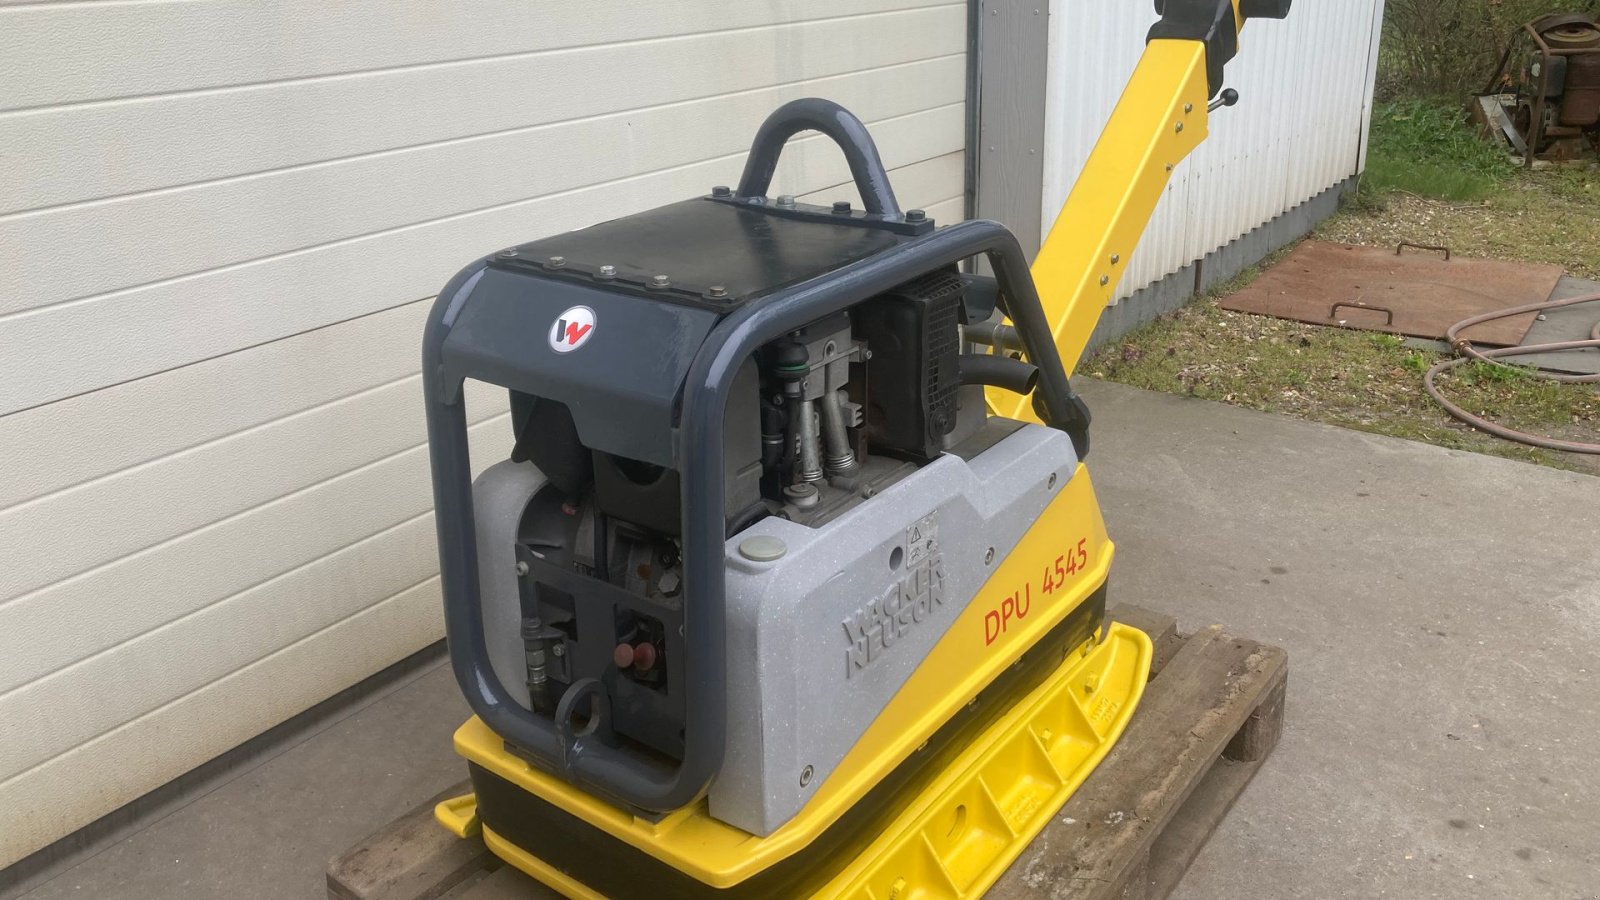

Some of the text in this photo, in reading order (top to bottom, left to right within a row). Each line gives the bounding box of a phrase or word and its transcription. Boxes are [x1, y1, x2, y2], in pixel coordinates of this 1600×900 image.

[842, 552, 946, 646] WACKER
[845, 578, 944, 680] NEUSON
[984, 538, 1087, 647] DPU 4545
